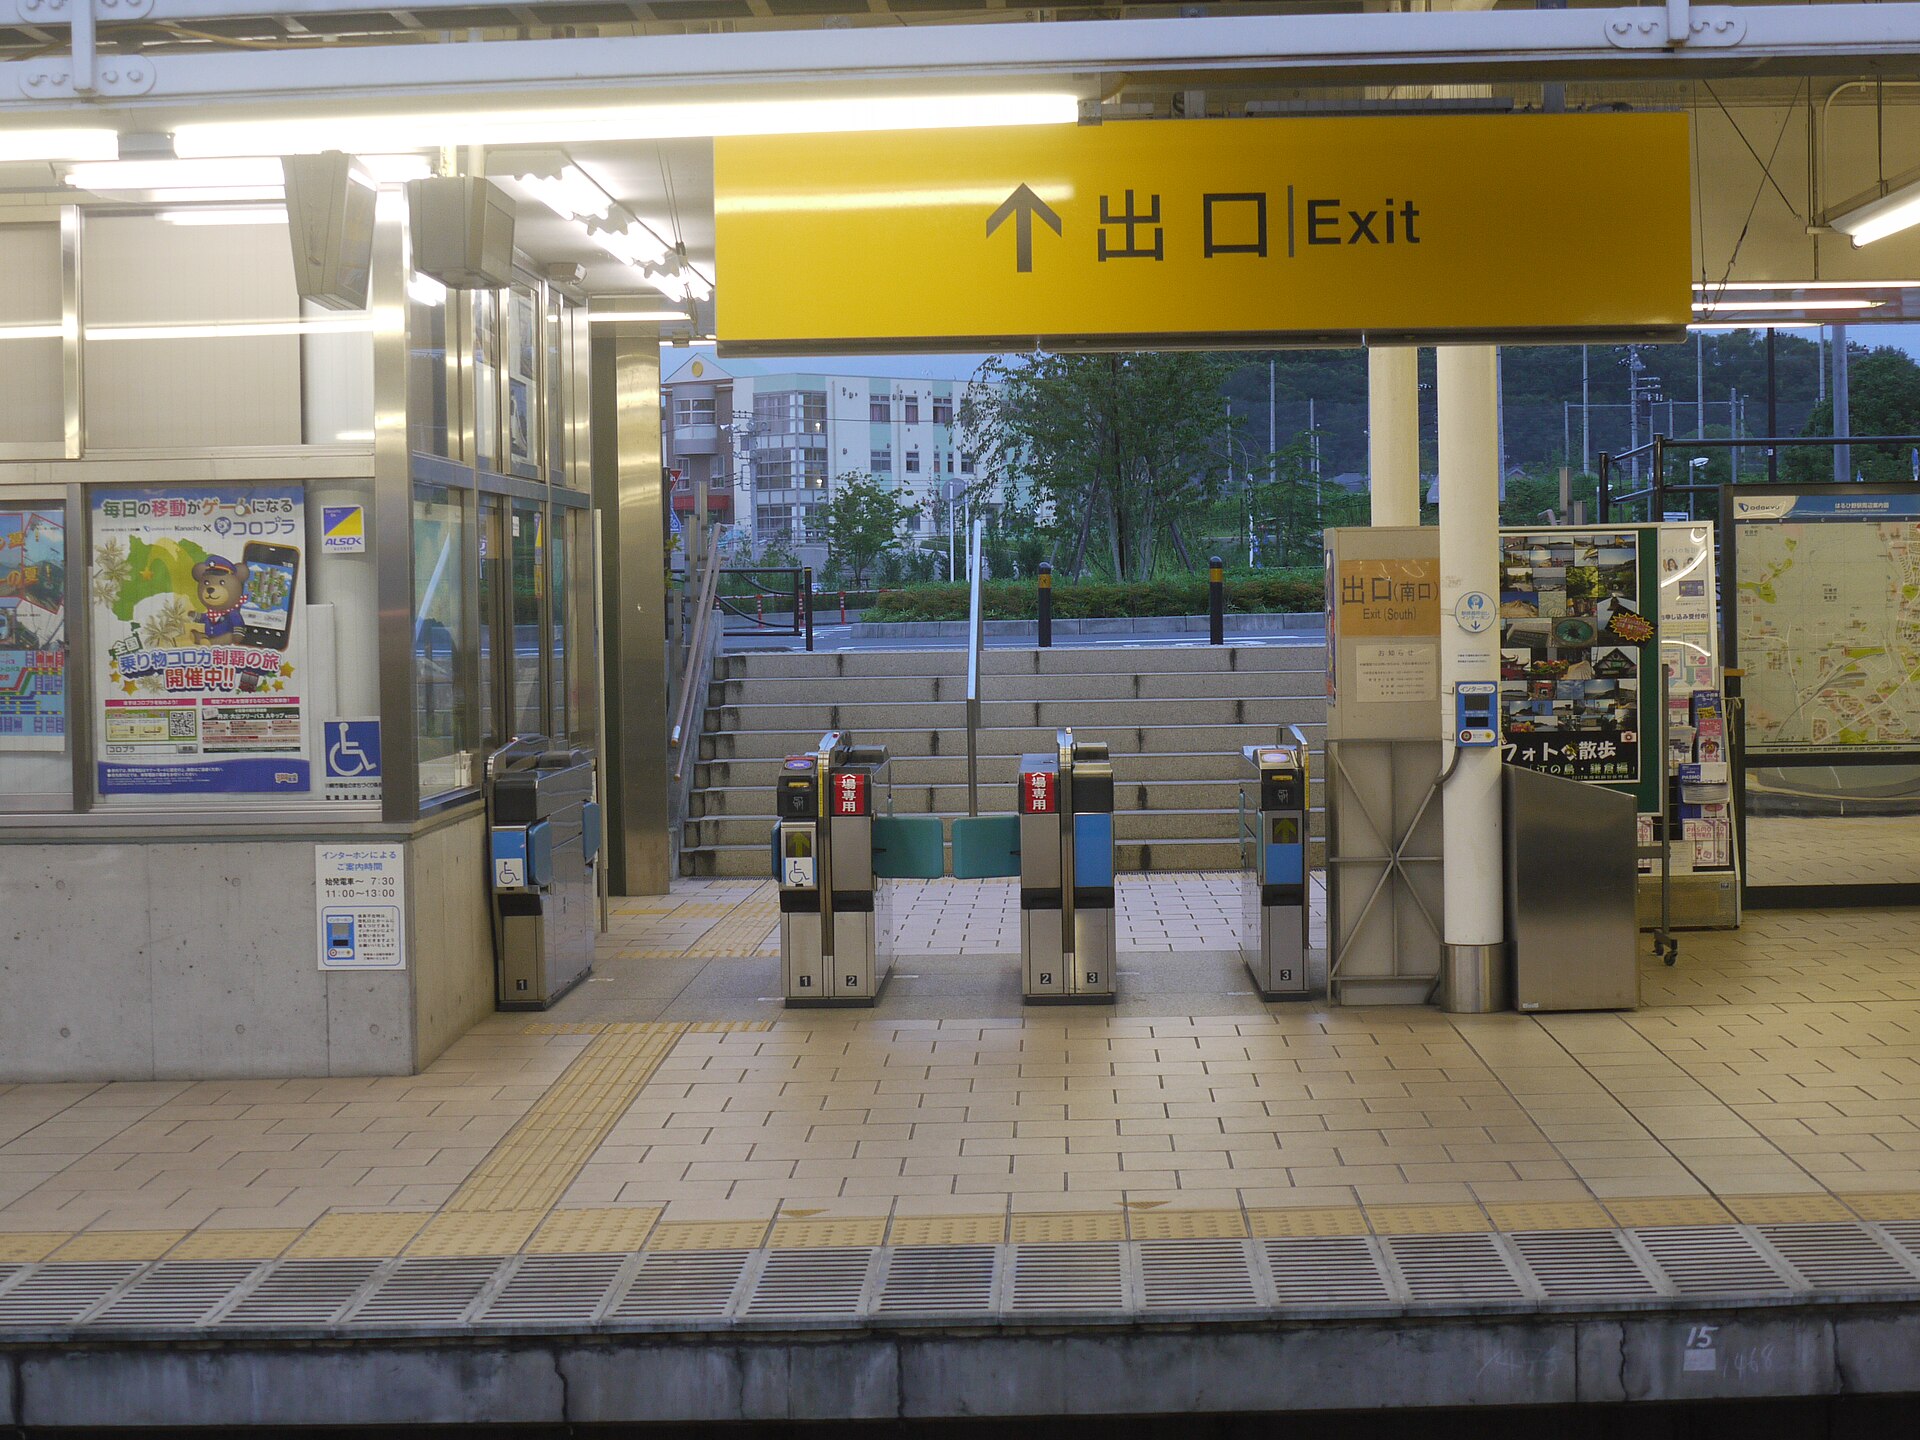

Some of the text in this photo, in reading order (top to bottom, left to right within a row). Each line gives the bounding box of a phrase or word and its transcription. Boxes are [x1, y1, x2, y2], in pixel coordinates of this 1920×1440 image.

[1097, 189, 1421, 262] 出口 Exit
[325, 537, 362, 546] ALSOK
[1363, 606, 1417, 621] Exit (South)
[119, 649, 281, 673] 乗り物コロカ制覇の旅
[165, 667, 235, 689] 開催中!!
[1578, 741, 1617, 760] 散歩
[321, 851, 397, 860] インターホンによる
[337, 862, 383, 871] ご案内時間
[371, 876, 395, 886] 7:30
[1041, 974, 1050, 984] 2
[1088, 973, 1097, 983] 3
[1281, 970, 1290, 980] 3
[847, 976, 856, 986] 2
[1686, 1326, 1719, 1348] 15
